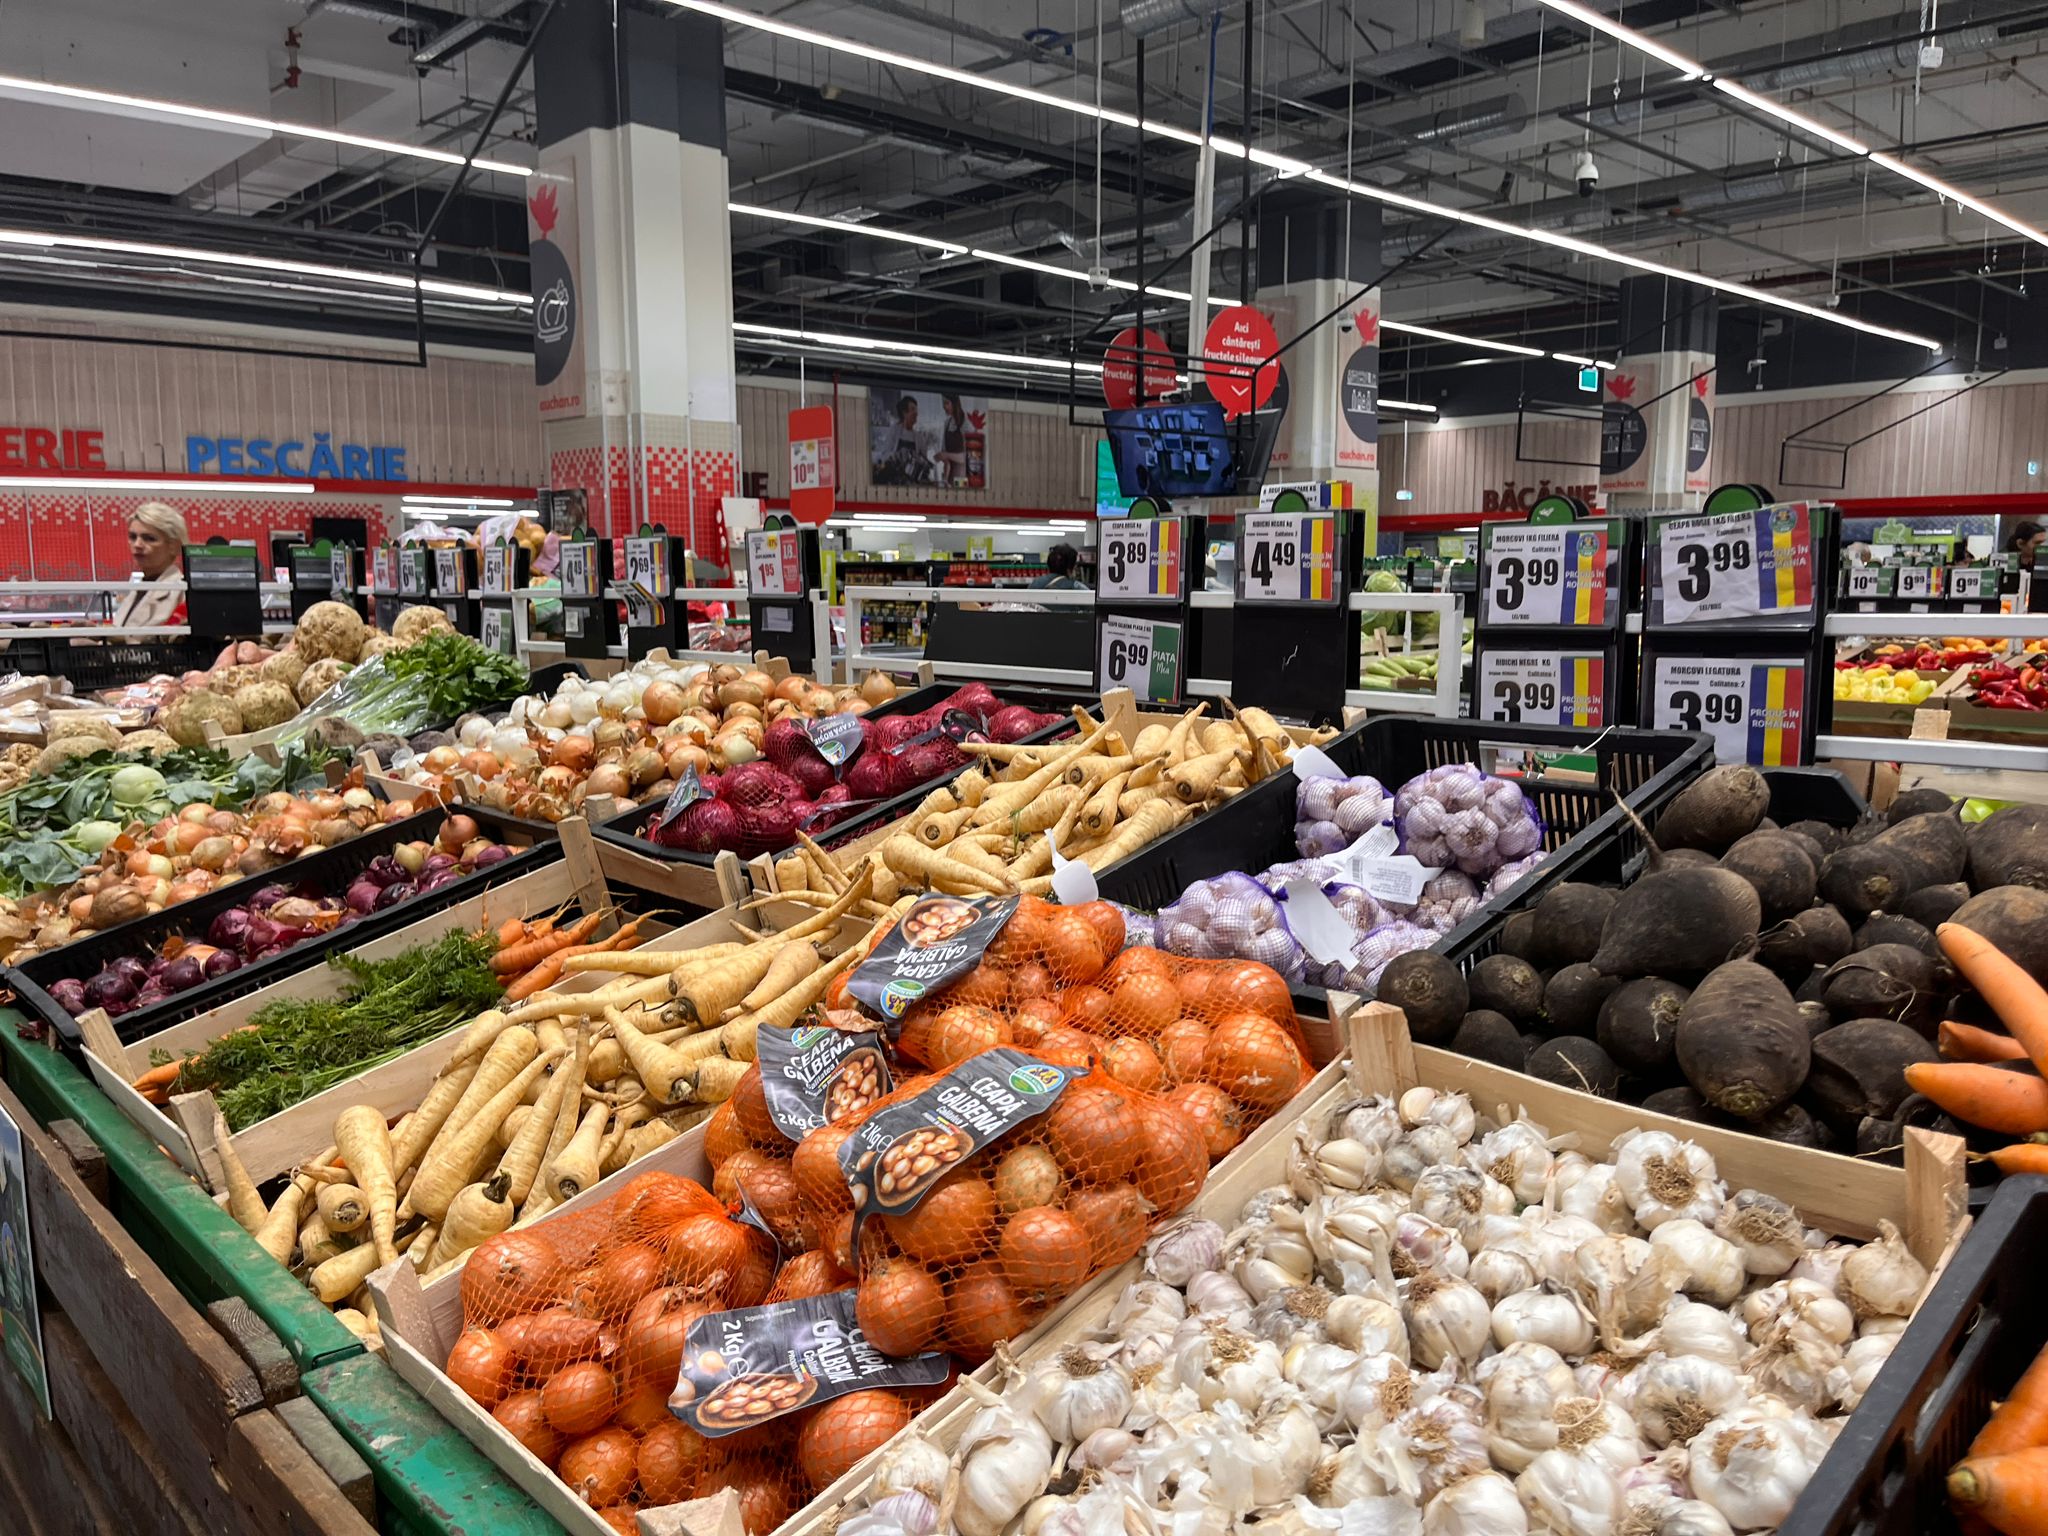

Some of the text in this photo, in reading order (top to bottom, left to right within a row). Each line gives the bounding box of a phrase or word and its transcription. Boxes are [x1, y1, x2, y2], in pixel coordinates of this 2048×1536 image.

[1234, 321, 1249, 333] Aici
[1205, 348, 1235, 361] fructele
[539, 394, 581, 411] auchan.ro
[186, 432, 409, 482] PESCĂRIE
[1338, 450, 1375, 462] auchan.ro
[1671, 666, 1741, 676] MORCOVI LEGATURA
[1561, 696, 1591, 704] PRODUS
[1750, 708, 1799, 718] PRODUS ÎN
[783, 1034, 855, 1084] GALBENĂ
[790, 1031, 842, 1070] CEAPĂ
[969, 1077, 1028, 1117] CEAPĂ
[937, 1086, 1009, 1136] GALBENĂ
[811, 1319, 863, 1385] GALBENĂ
